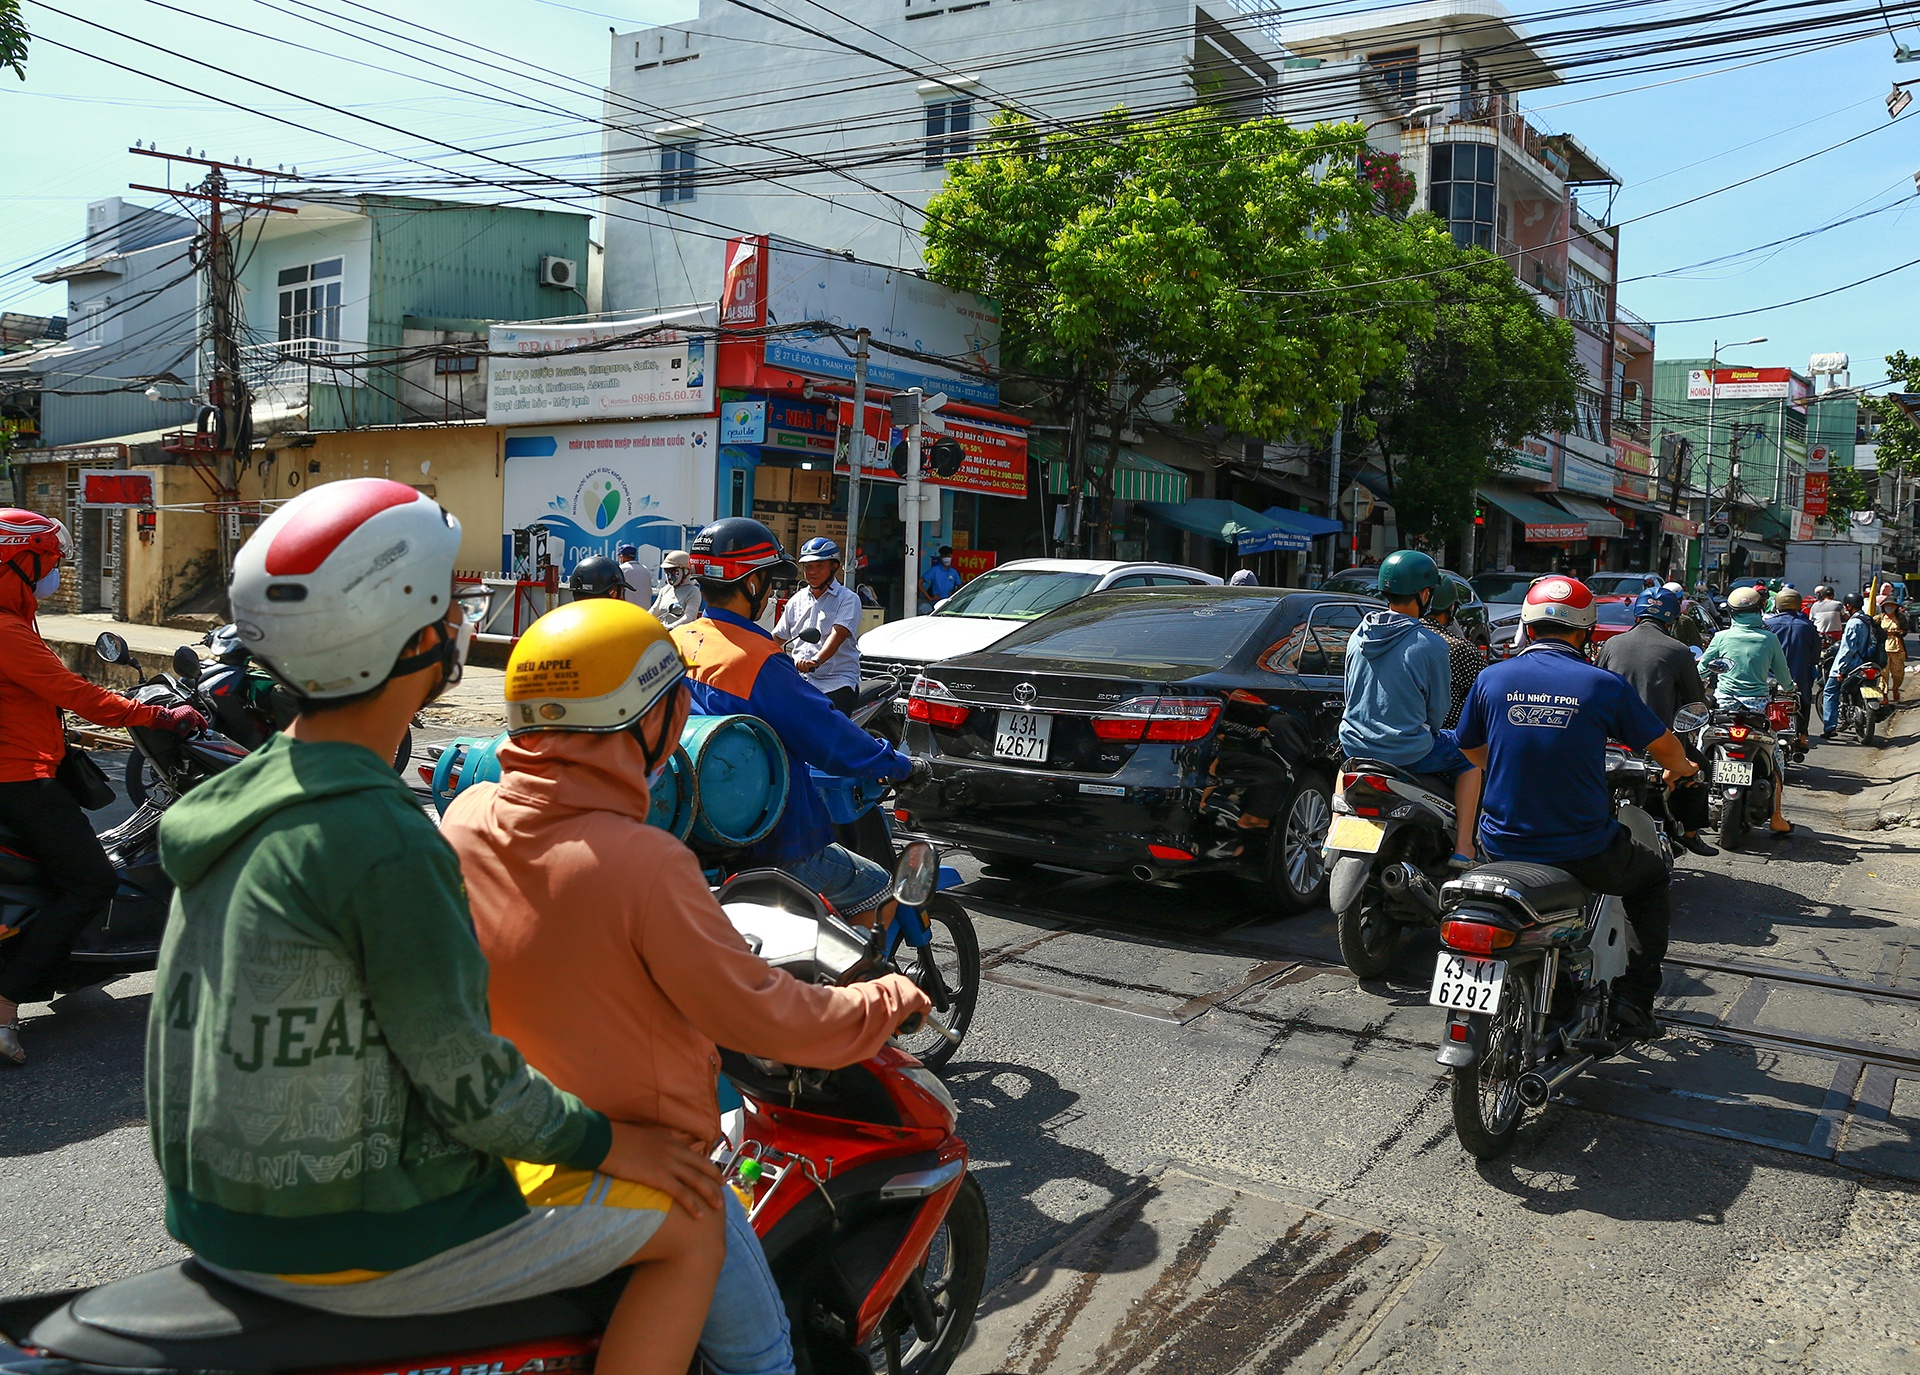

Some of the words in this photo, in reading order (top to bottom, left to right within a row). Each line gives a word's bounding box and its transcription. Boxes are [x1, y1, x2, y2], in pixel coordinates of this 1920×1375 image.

[783, 351, 790, 360] 27
[792, 352, 800, 362] LÊ
[822, 359, 844, 372] THANH
[632, 390, 702, 403] 0896.65.60.74
[786, 407, 814, 430] NHÀ
[958, 555, 987, 570] MÁY
[538, 658, 572, 670] APPLE
[1506, 690, 1524, 702] DẦU
[1528, 692, 1552, 704] NHỚT
[1554, 696, 1580, 706] FPOIL
[1010, 714, 1037, 736] 43A
[996, 734, 1044, 760] 426.71
[1722, 763, 1746, 774] 43-C1
[1718, 773, 1750, 784] 540.23
[1470, 874, 1511, 884] HONDA
[1444, 956, 1497, 985] 43-K1
[1439, 982, 1492, 1010] 6292
